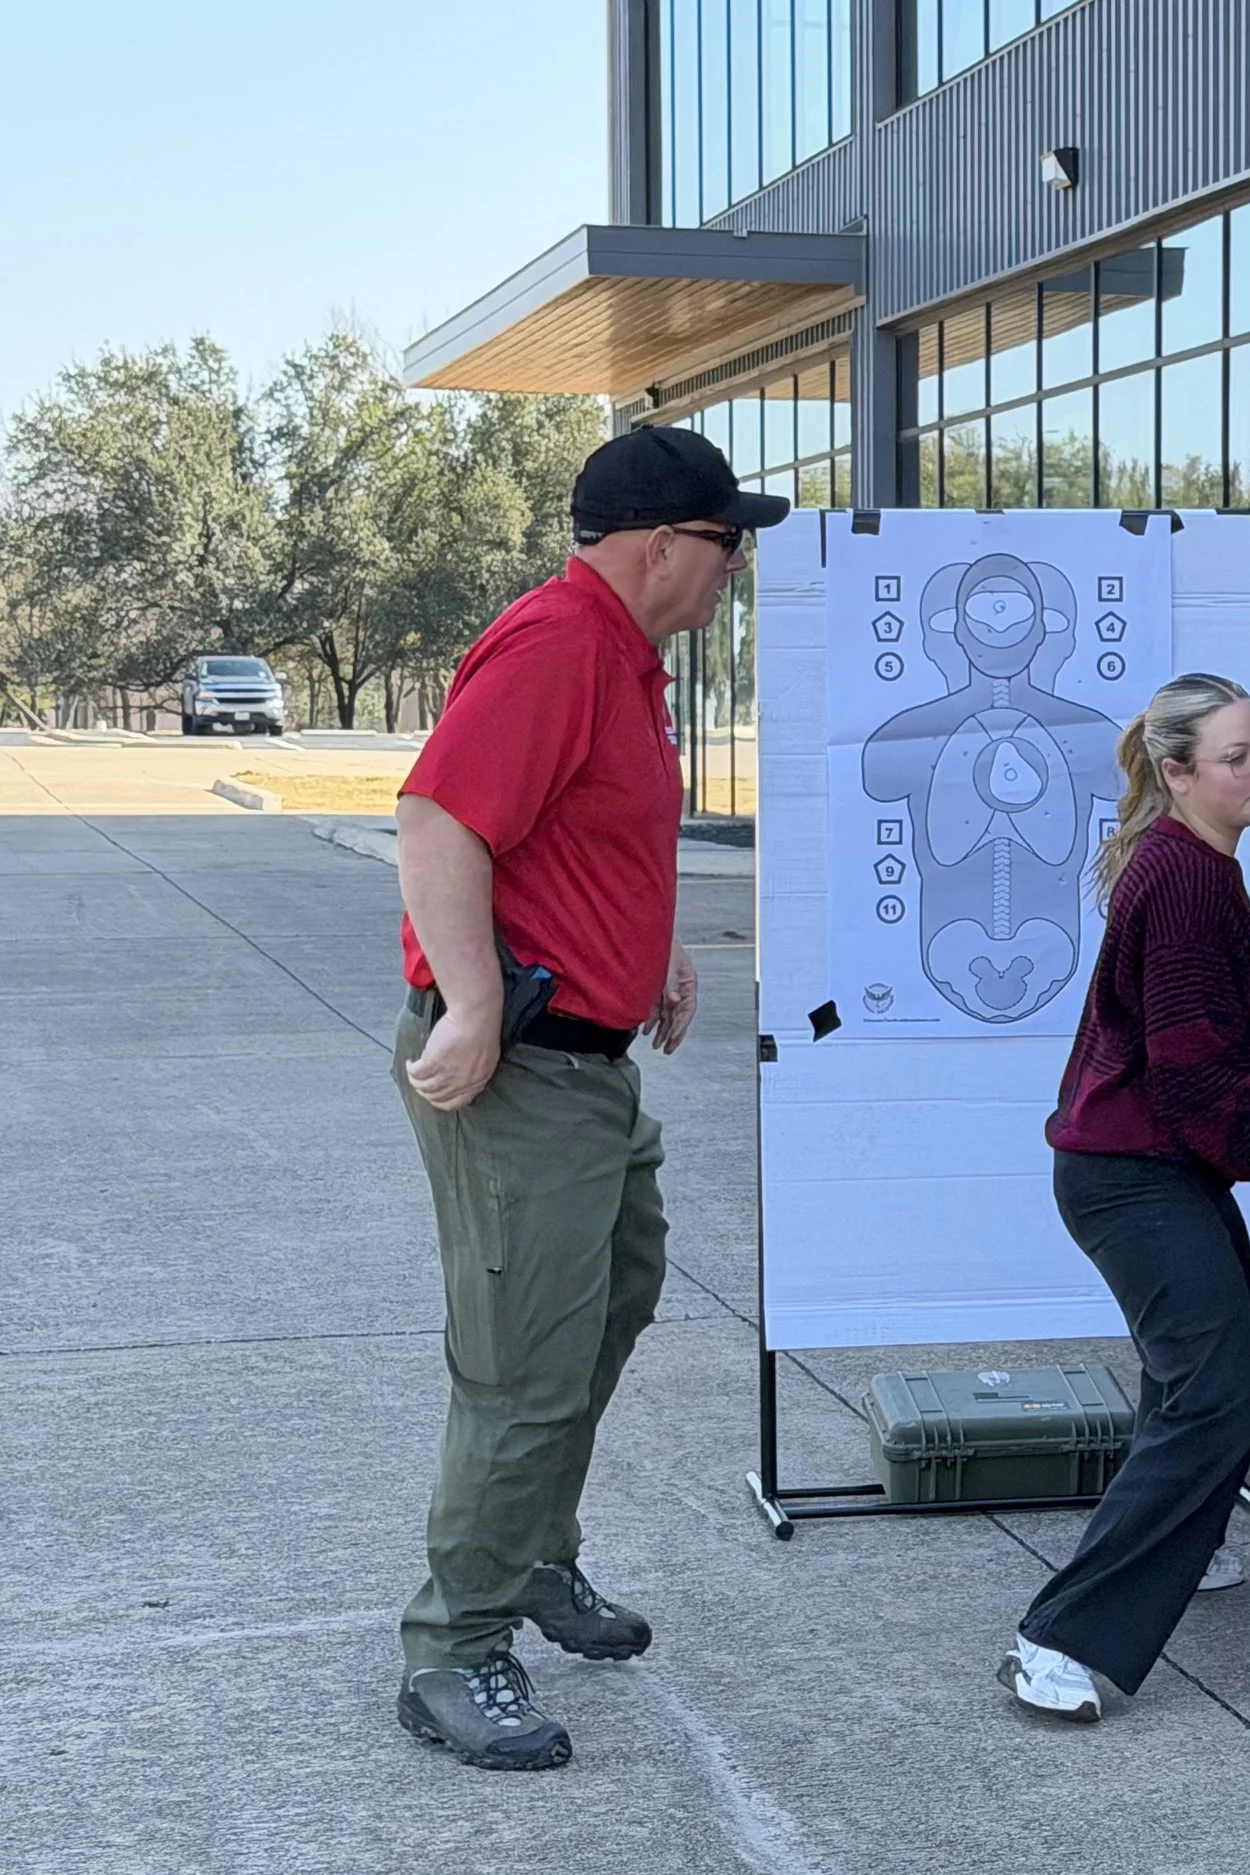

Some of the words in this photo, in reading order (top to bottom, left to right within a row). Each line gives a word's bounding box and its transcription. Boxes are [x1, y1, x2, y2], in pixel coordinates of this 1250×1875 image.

[883, 583, 891, 595] 1
[1106, 583, 1116, 595] 2
[883, 621, 893, 634] 3
[1106, 621, 1116, 634] 4
[884, 661, 894, 673] 5
[1106, 660, 1116, 673] 6
[884, 827, 894, 839] 7
[885, 865, 895, 877] 9
[882, 903, 897, 916] 11
